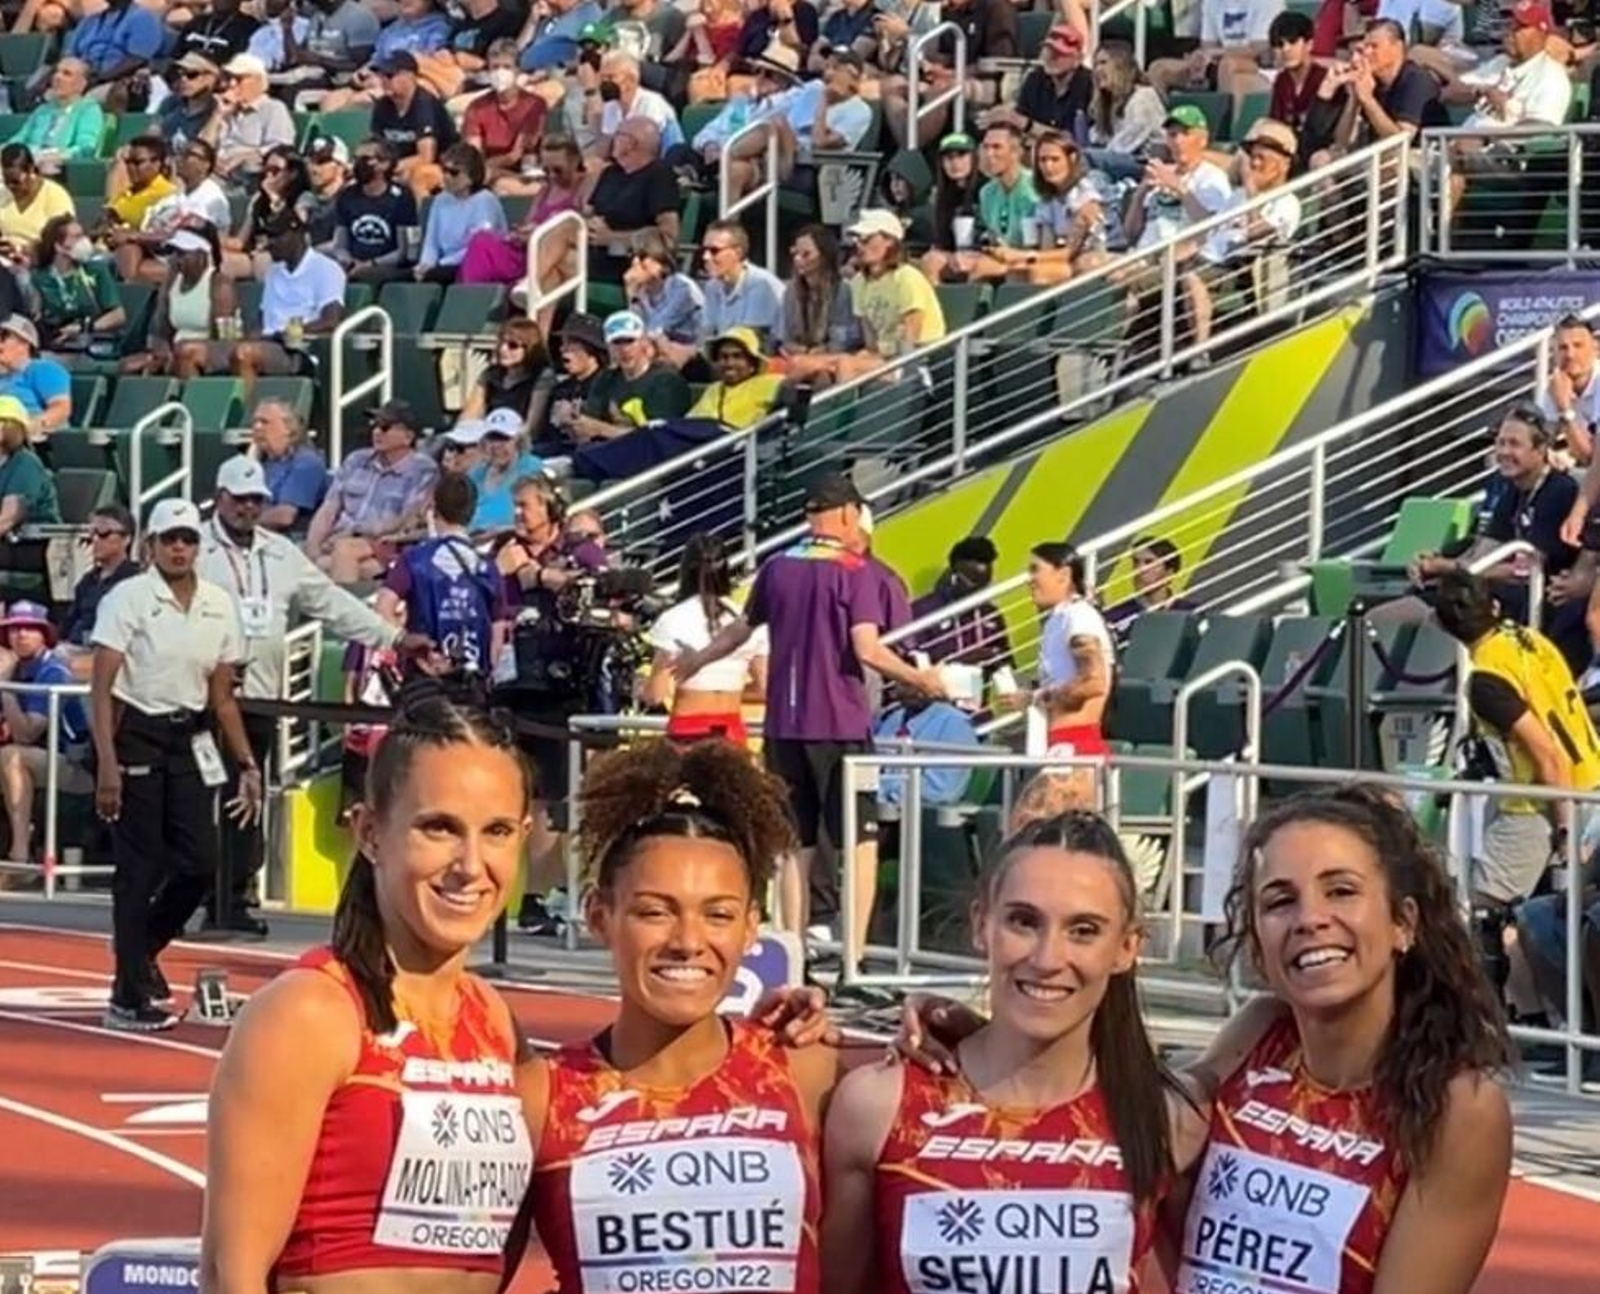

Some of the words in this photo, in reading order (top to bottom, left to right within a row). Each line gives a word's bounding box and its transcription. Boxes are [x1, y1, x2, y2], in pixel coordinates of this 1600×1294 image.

[401, 1056, 513, 1087] ESPAÑA
[464, 1107, 515, 1143] QNB
[583, 1105, 788, 1151] ESPAÑA
[1232, 1099, 1385, 1167] ESPAÑA
[666, 1150, 770, 1187] QNB
[917, 1134, 1124, 1171] ESPAÑA
[1243, 1168, 1332, 1217] QNB
[596, 1199, 786, 1255] BESTUÉ
[995, 1203, 1100, 1239] QNB
[1195, 1214, 1313, 1283] PÉREZ
[617, 1265, 771, 1293] OREGON22
